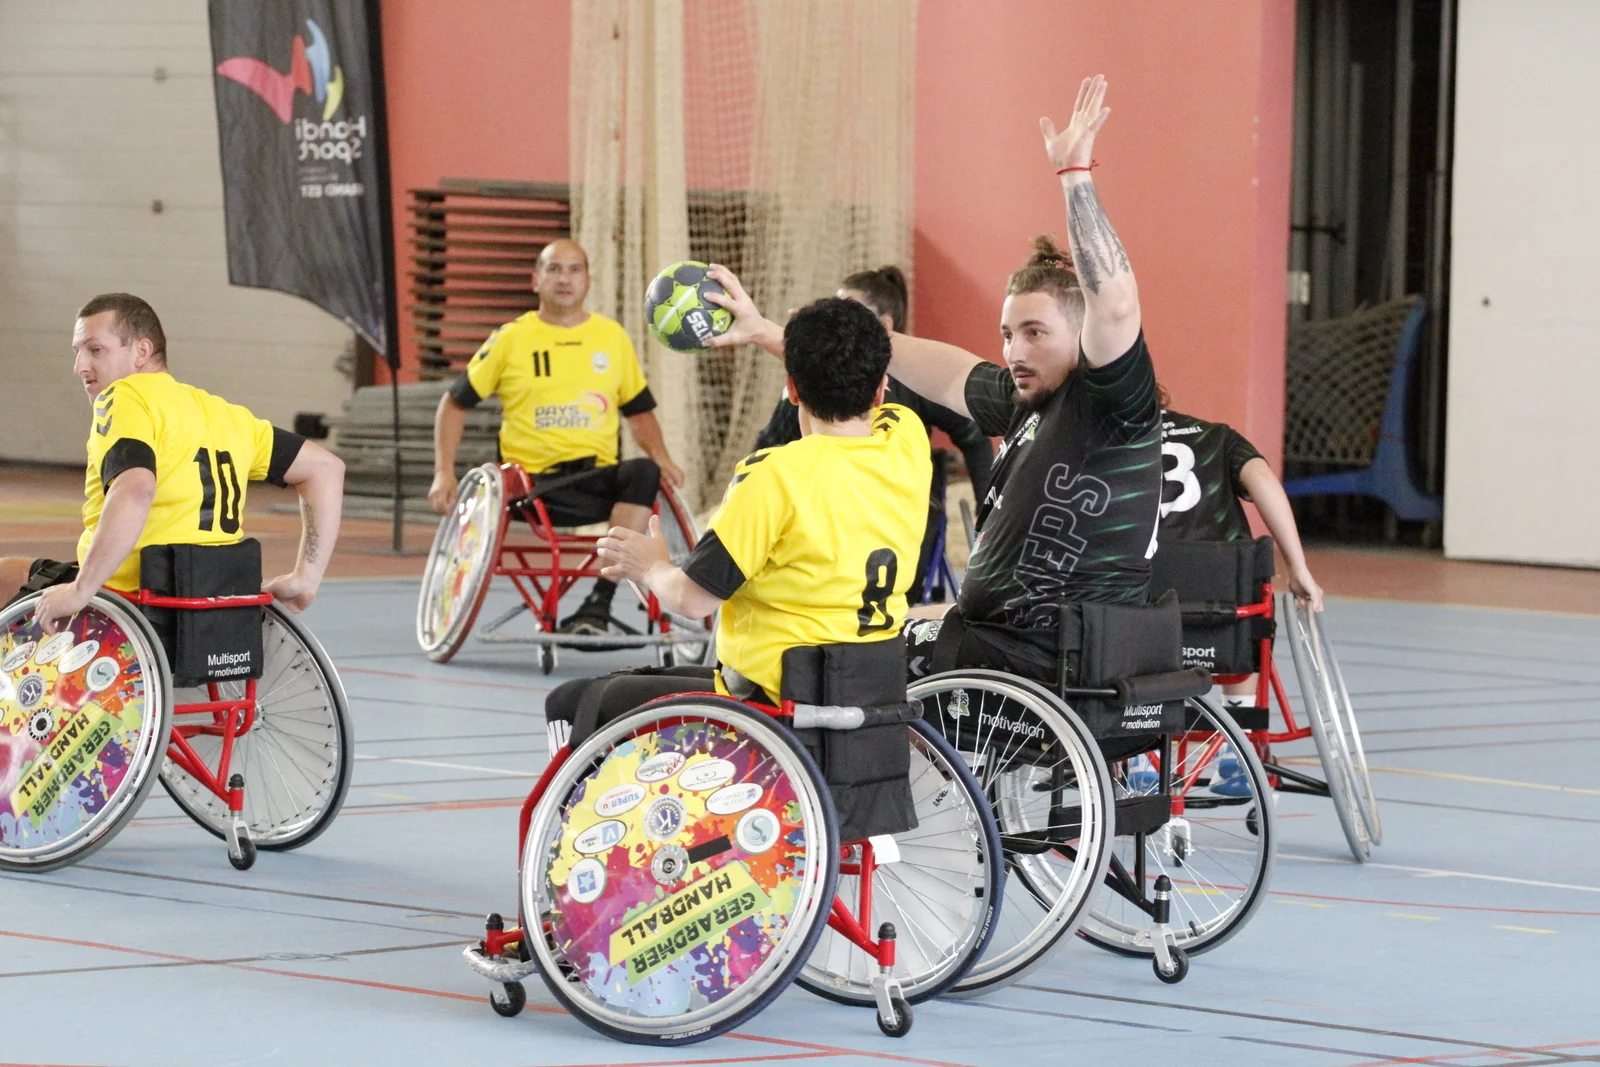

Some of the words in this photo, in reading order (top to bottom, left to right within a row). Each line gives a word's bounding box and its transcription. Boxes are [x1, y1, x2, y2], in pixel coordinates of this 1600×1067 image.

[533, 351, 551, 377] 11
[535, 405, 579, 417] PAYS
[535, 416, 590, 430] SPORT
[193, 447, 241, 534] 10
[857, 548, 897, 637] 8
[208, 651, 250, 666] Multisport
[215, 666, 250, 677] motivation
[1124, 703, 1162, 718] Multisport
[979, 713, 1045, 739] motivation
[1126, 719, 1160, 729] motivation
[19, 713, 90, 798] HANDBALL
[33, 720, 111, 818] GERARDMER
[611, 792, 640, 807] SUPER
[621, 873, 732, 945] HANDBALL
[633, 891, 756, 974] GERARDMER
